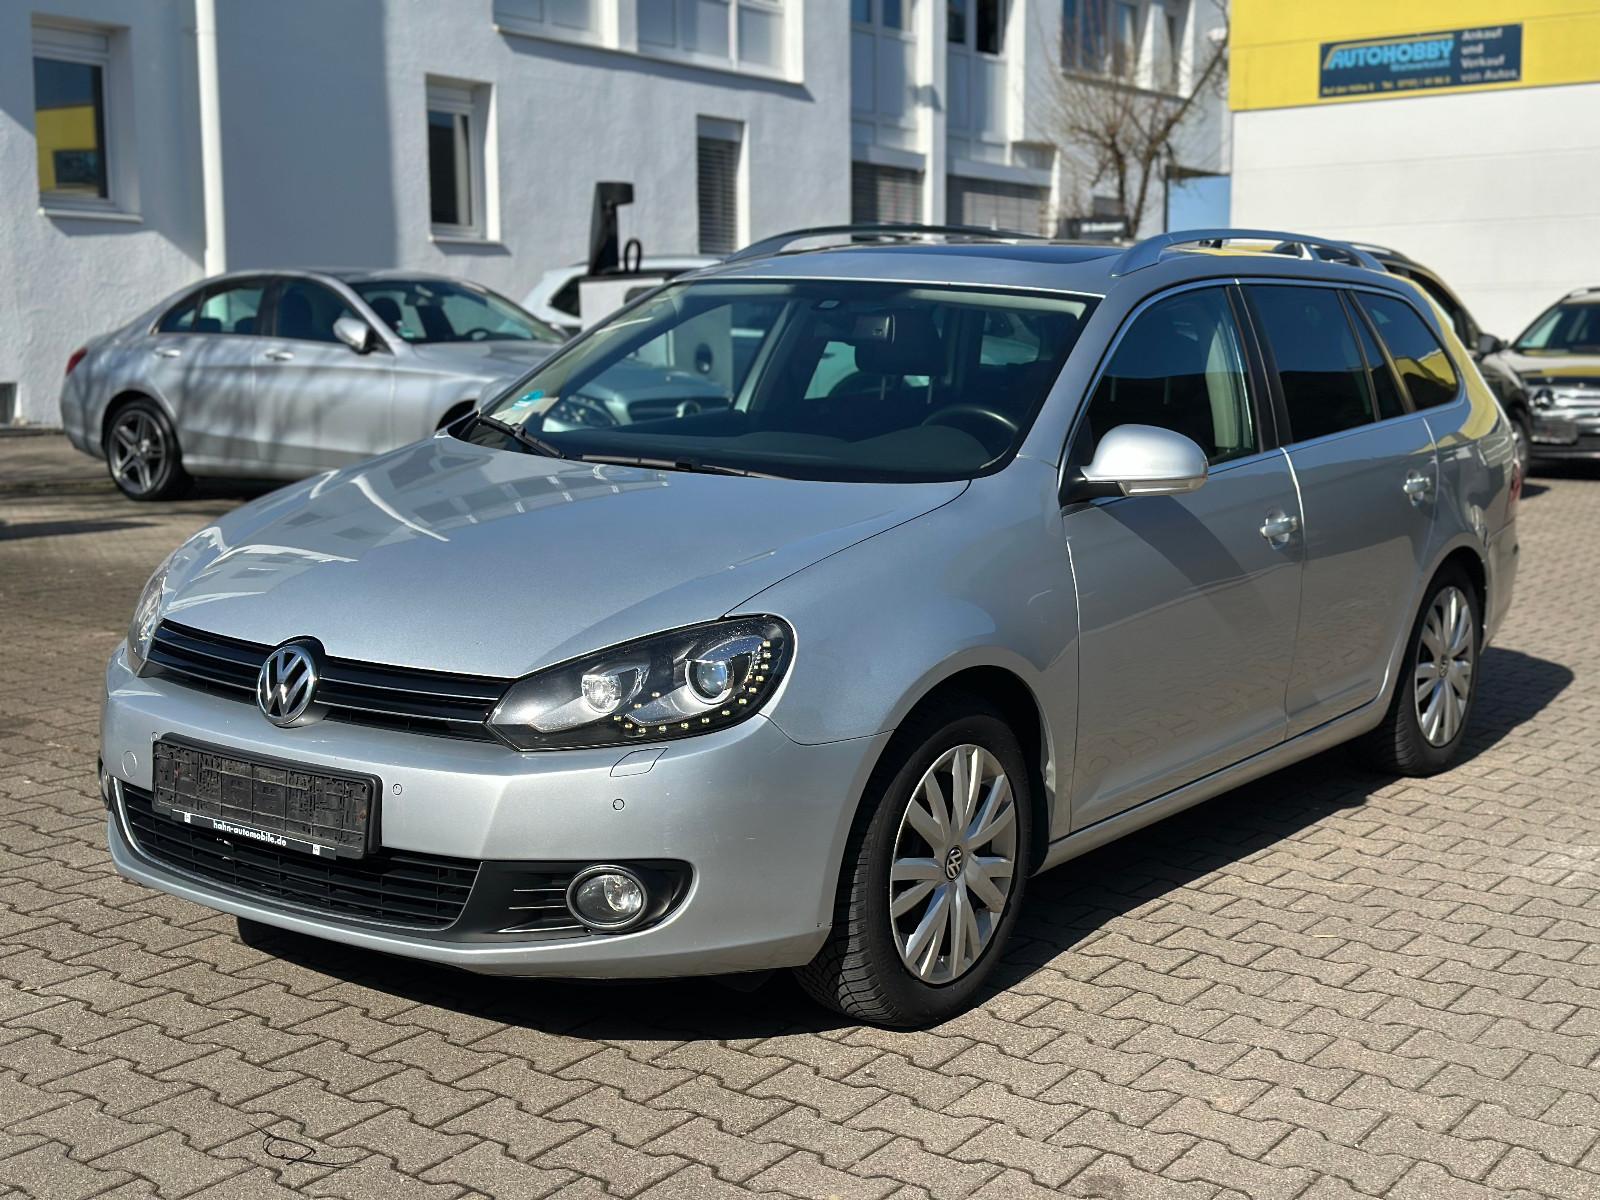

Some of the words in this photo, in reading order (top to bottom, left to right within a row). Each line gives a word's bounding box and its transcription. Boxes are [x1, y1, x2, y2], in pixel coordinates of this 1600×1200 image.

[1461, 28, 1503, 41] Ankauf
[1328, 41, 1454, 69] AUTOHOBBY
[1461, 43, 1484, 55] und
[1460, 54, 1505, 69] Verkauf
[213, 819, 287, 847] hahn-automobile.de
